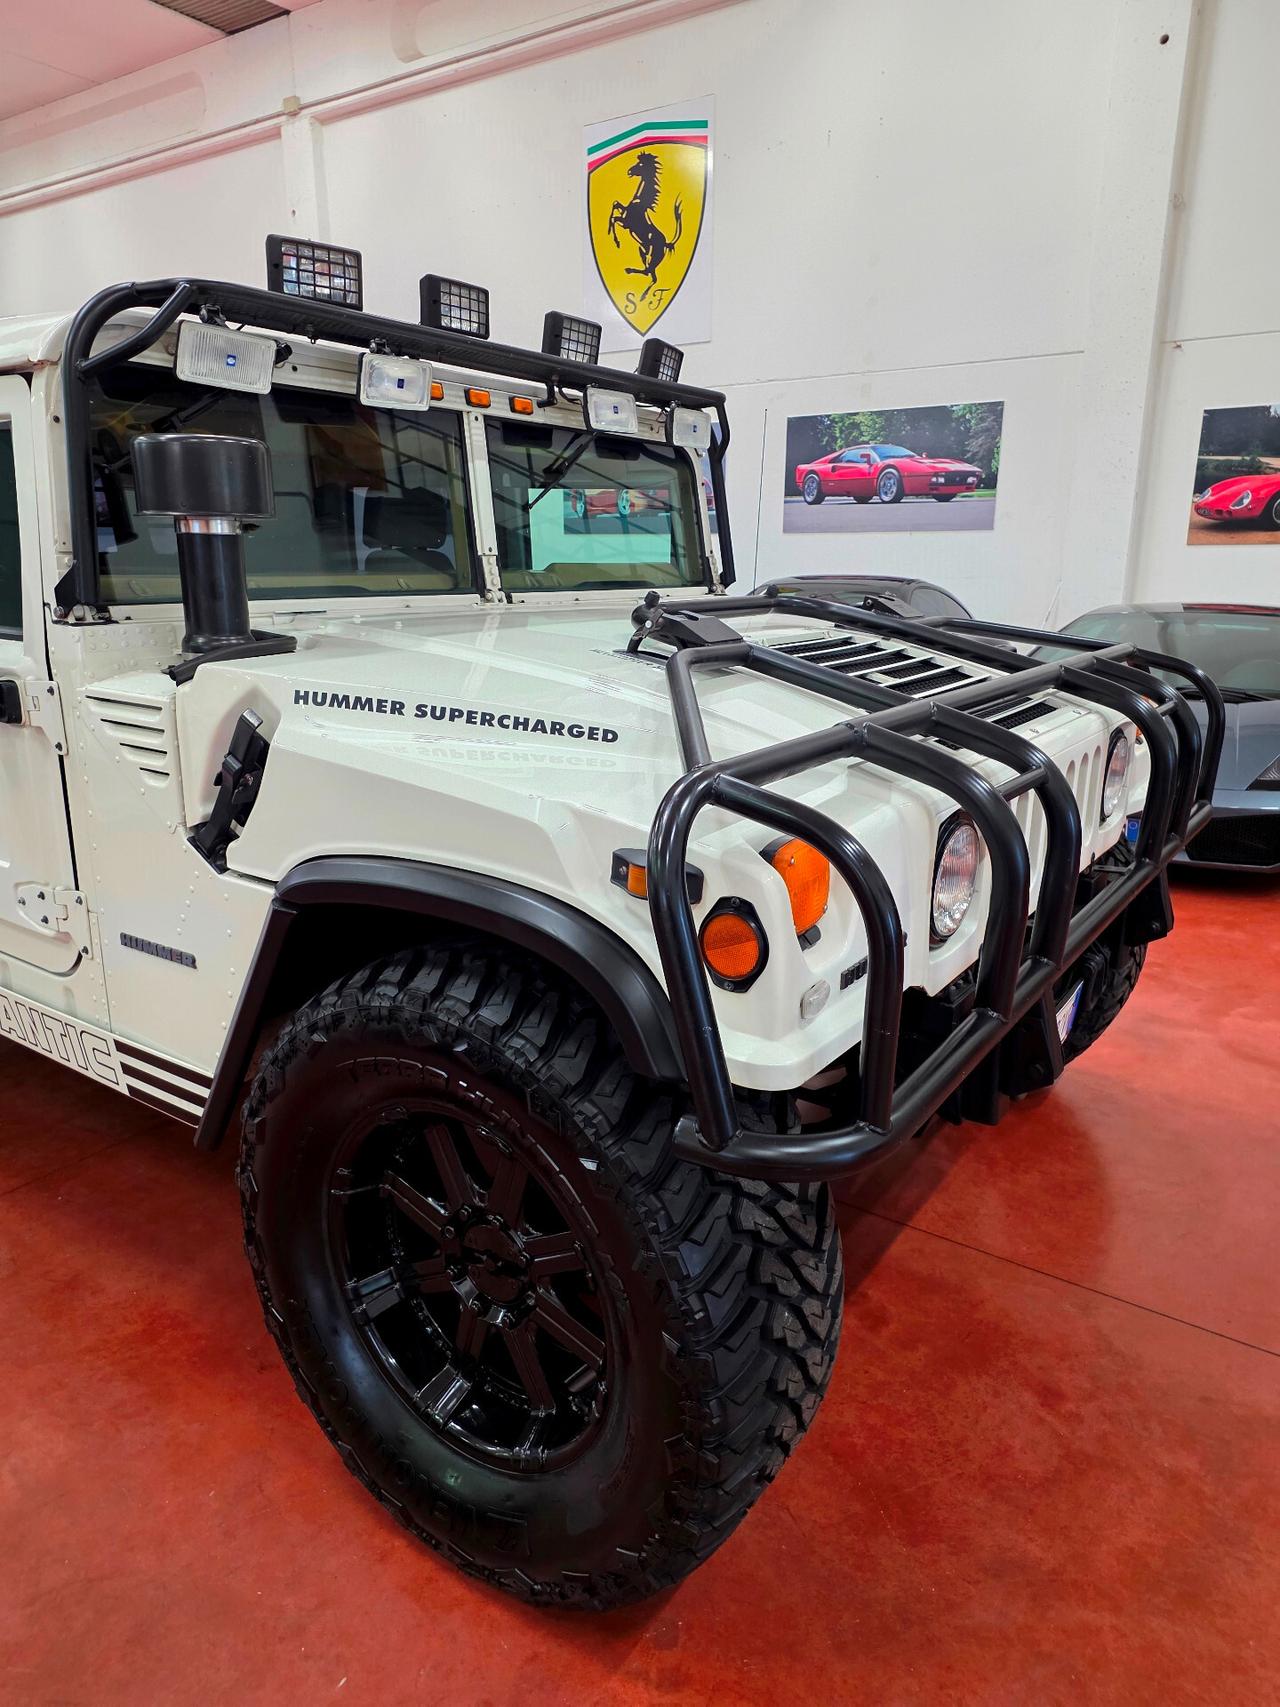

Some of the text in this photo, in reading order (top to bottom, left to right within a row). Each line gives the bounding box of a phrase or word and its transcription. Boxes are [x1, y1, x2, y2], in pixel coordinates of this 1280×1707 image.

[624, 292, 637, 314] S
[294, 689, 619, 744] HUMMER SUPERCHARGED
[120, 932, 198, 969] HUMMER
